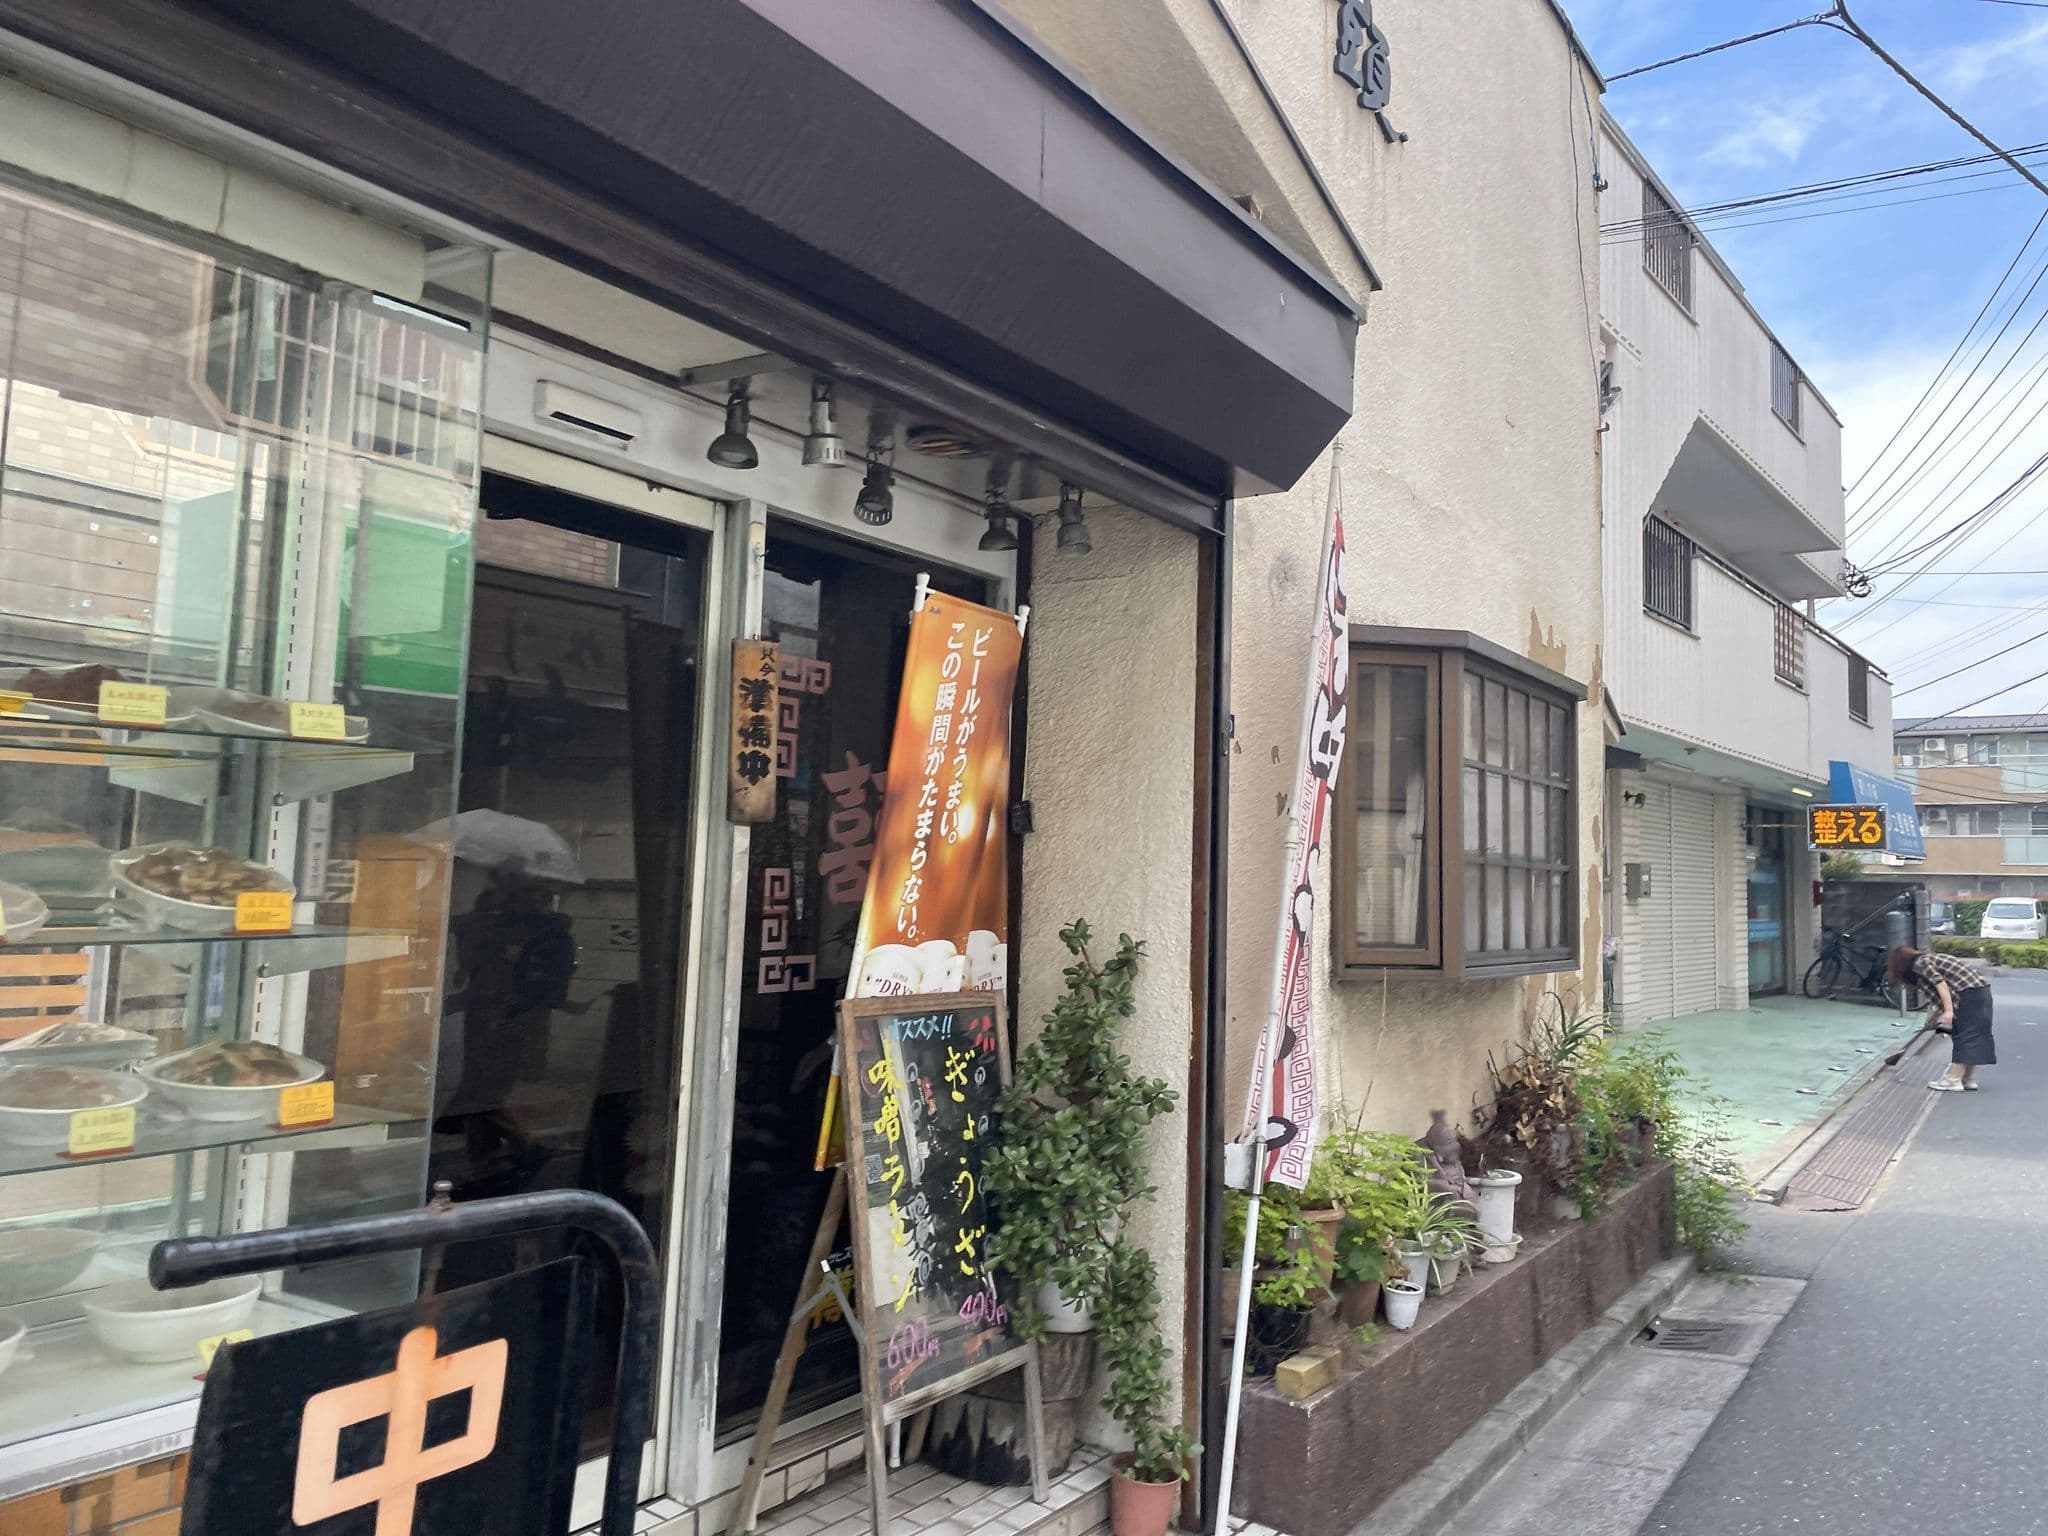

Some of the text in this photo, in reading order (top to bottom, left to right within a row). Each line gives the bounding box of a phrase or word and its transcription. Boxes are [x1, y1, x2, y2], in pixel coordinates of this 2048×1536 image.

[896, 622, 968, 940] この瞬間がたまらない。
[939, 627, 993, 844] ビールがうまい。
[1813, 808, 1882, 845] 整える
[943, 1045, 986, 1278] ぎょうざ
[291, 1324, 509, 1536] 中
